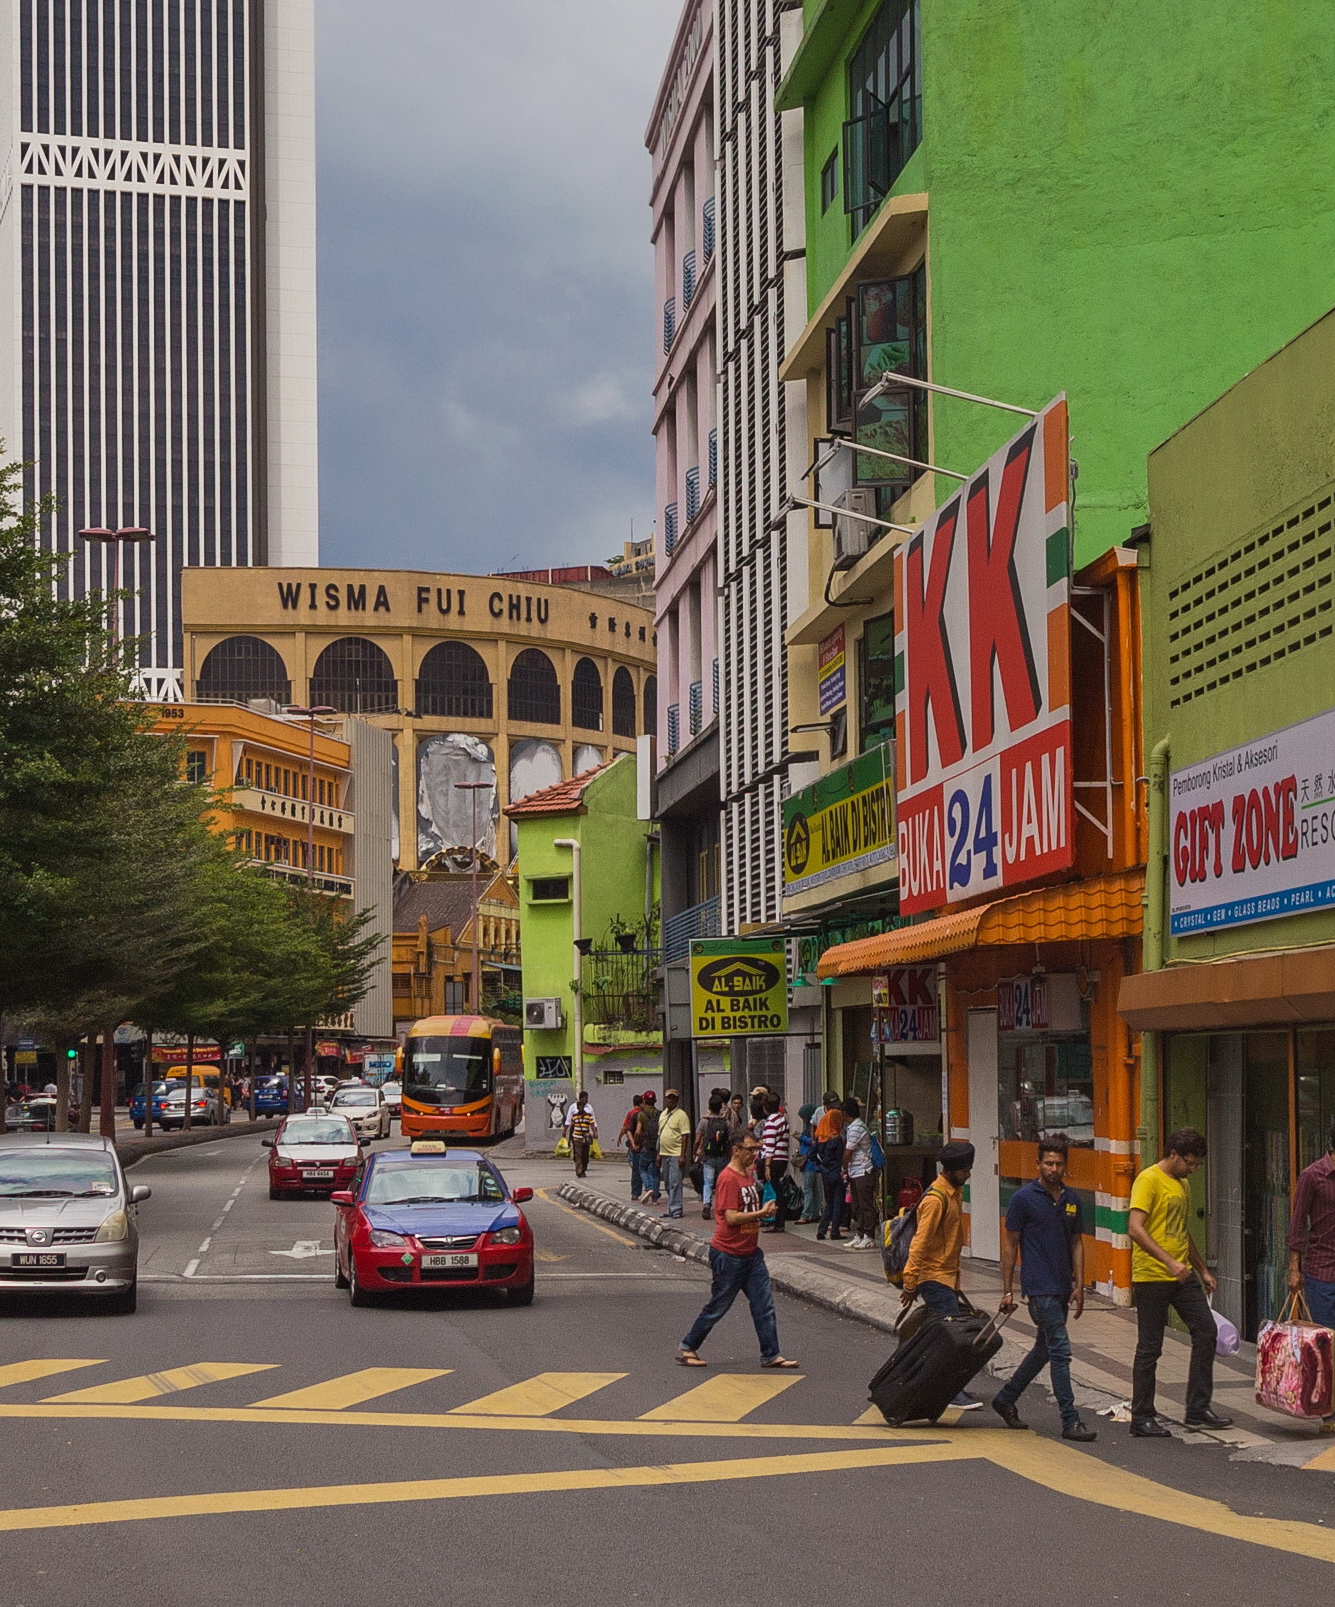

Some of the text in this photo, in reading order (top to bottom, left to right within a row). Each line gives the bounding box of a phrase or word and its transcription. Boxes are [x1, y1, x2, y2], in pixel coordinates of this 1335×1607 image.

[277, 582, 550, 624] WISMA FUI CHIU
[907, 422, 1043, 785] KK
[161, 707, 184, 719] 1953
[1173, 739, 1278, 797] Pemborong Kristal & Aksesori
[821, 782, 892, 865] AL BAIK DI BISTRO
[898, 805, 944, 901] BUKA
[947, 773, 998, 890] 24
[1004, 746, 1066, 865] JAM
[1174, 774, 1299, 887] GIFT ZONE
[1179, 914, 1205, 928] CRYSTAL
[1213, 908, 1226, 921] GEM
[1234, 903, 1255, 917] GLASS
[1258, 897, 1280, 912] BEADS
[1291, 890, 1314, 906] PEARL
[712, 975, 766, 992] AL-BAIK
[698, 1013, 782, 1031] DI BISTRO
[704, 997, 770, 1013] AL BAIK
[899, 1009, 918, 1041] 24
[19, 1255, 57, 1264] WUN 1655
[429, 1256, 470, 1266] HBB 1588
